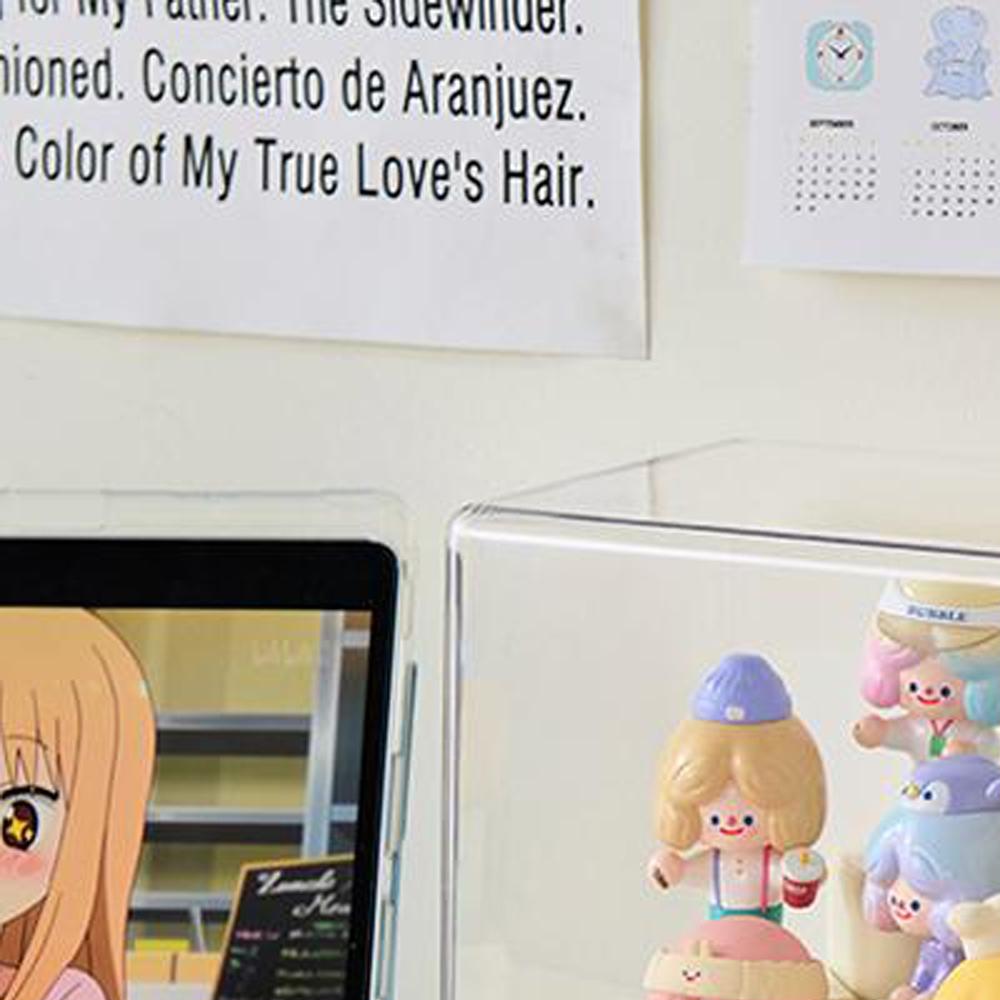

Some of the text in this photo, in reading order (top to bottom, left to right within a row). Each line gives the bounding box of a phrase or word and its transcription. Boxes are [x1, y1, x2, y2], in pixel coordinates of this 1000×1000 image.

[142, 47, 324, 110] Concierto
[341, 57, 386, 113] de
[402, 59, 586, 131] Aranjuez.
[15, 125, 595, 209] Color of My True Love's Hair.
